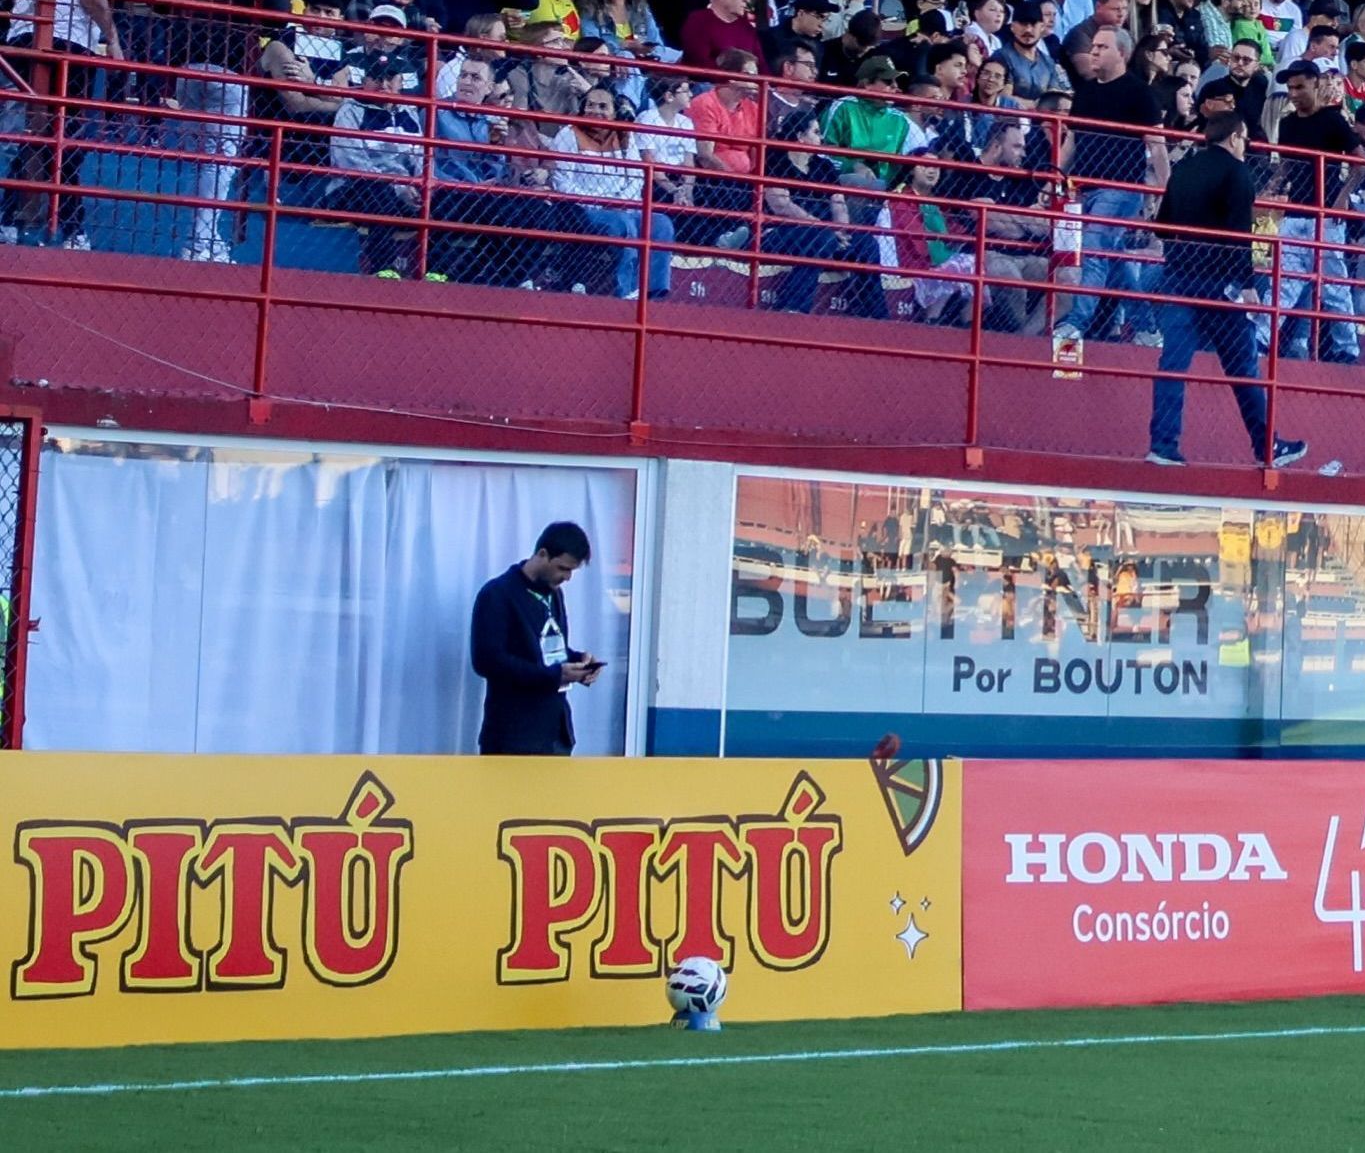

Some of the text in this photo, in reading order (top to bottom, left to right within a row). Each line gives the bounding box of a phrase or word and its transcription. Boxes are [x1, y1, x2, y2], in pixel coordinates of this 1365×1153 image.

[951, 656, 1209, 697] Por BOUTON
[497, 770, 843, 986] PITÚ
[1005, 832, 1287, 884] HONDA
[11, 770, 413, 1000] PITÚ
[1073, 900, 1230, 945] Consórcio
